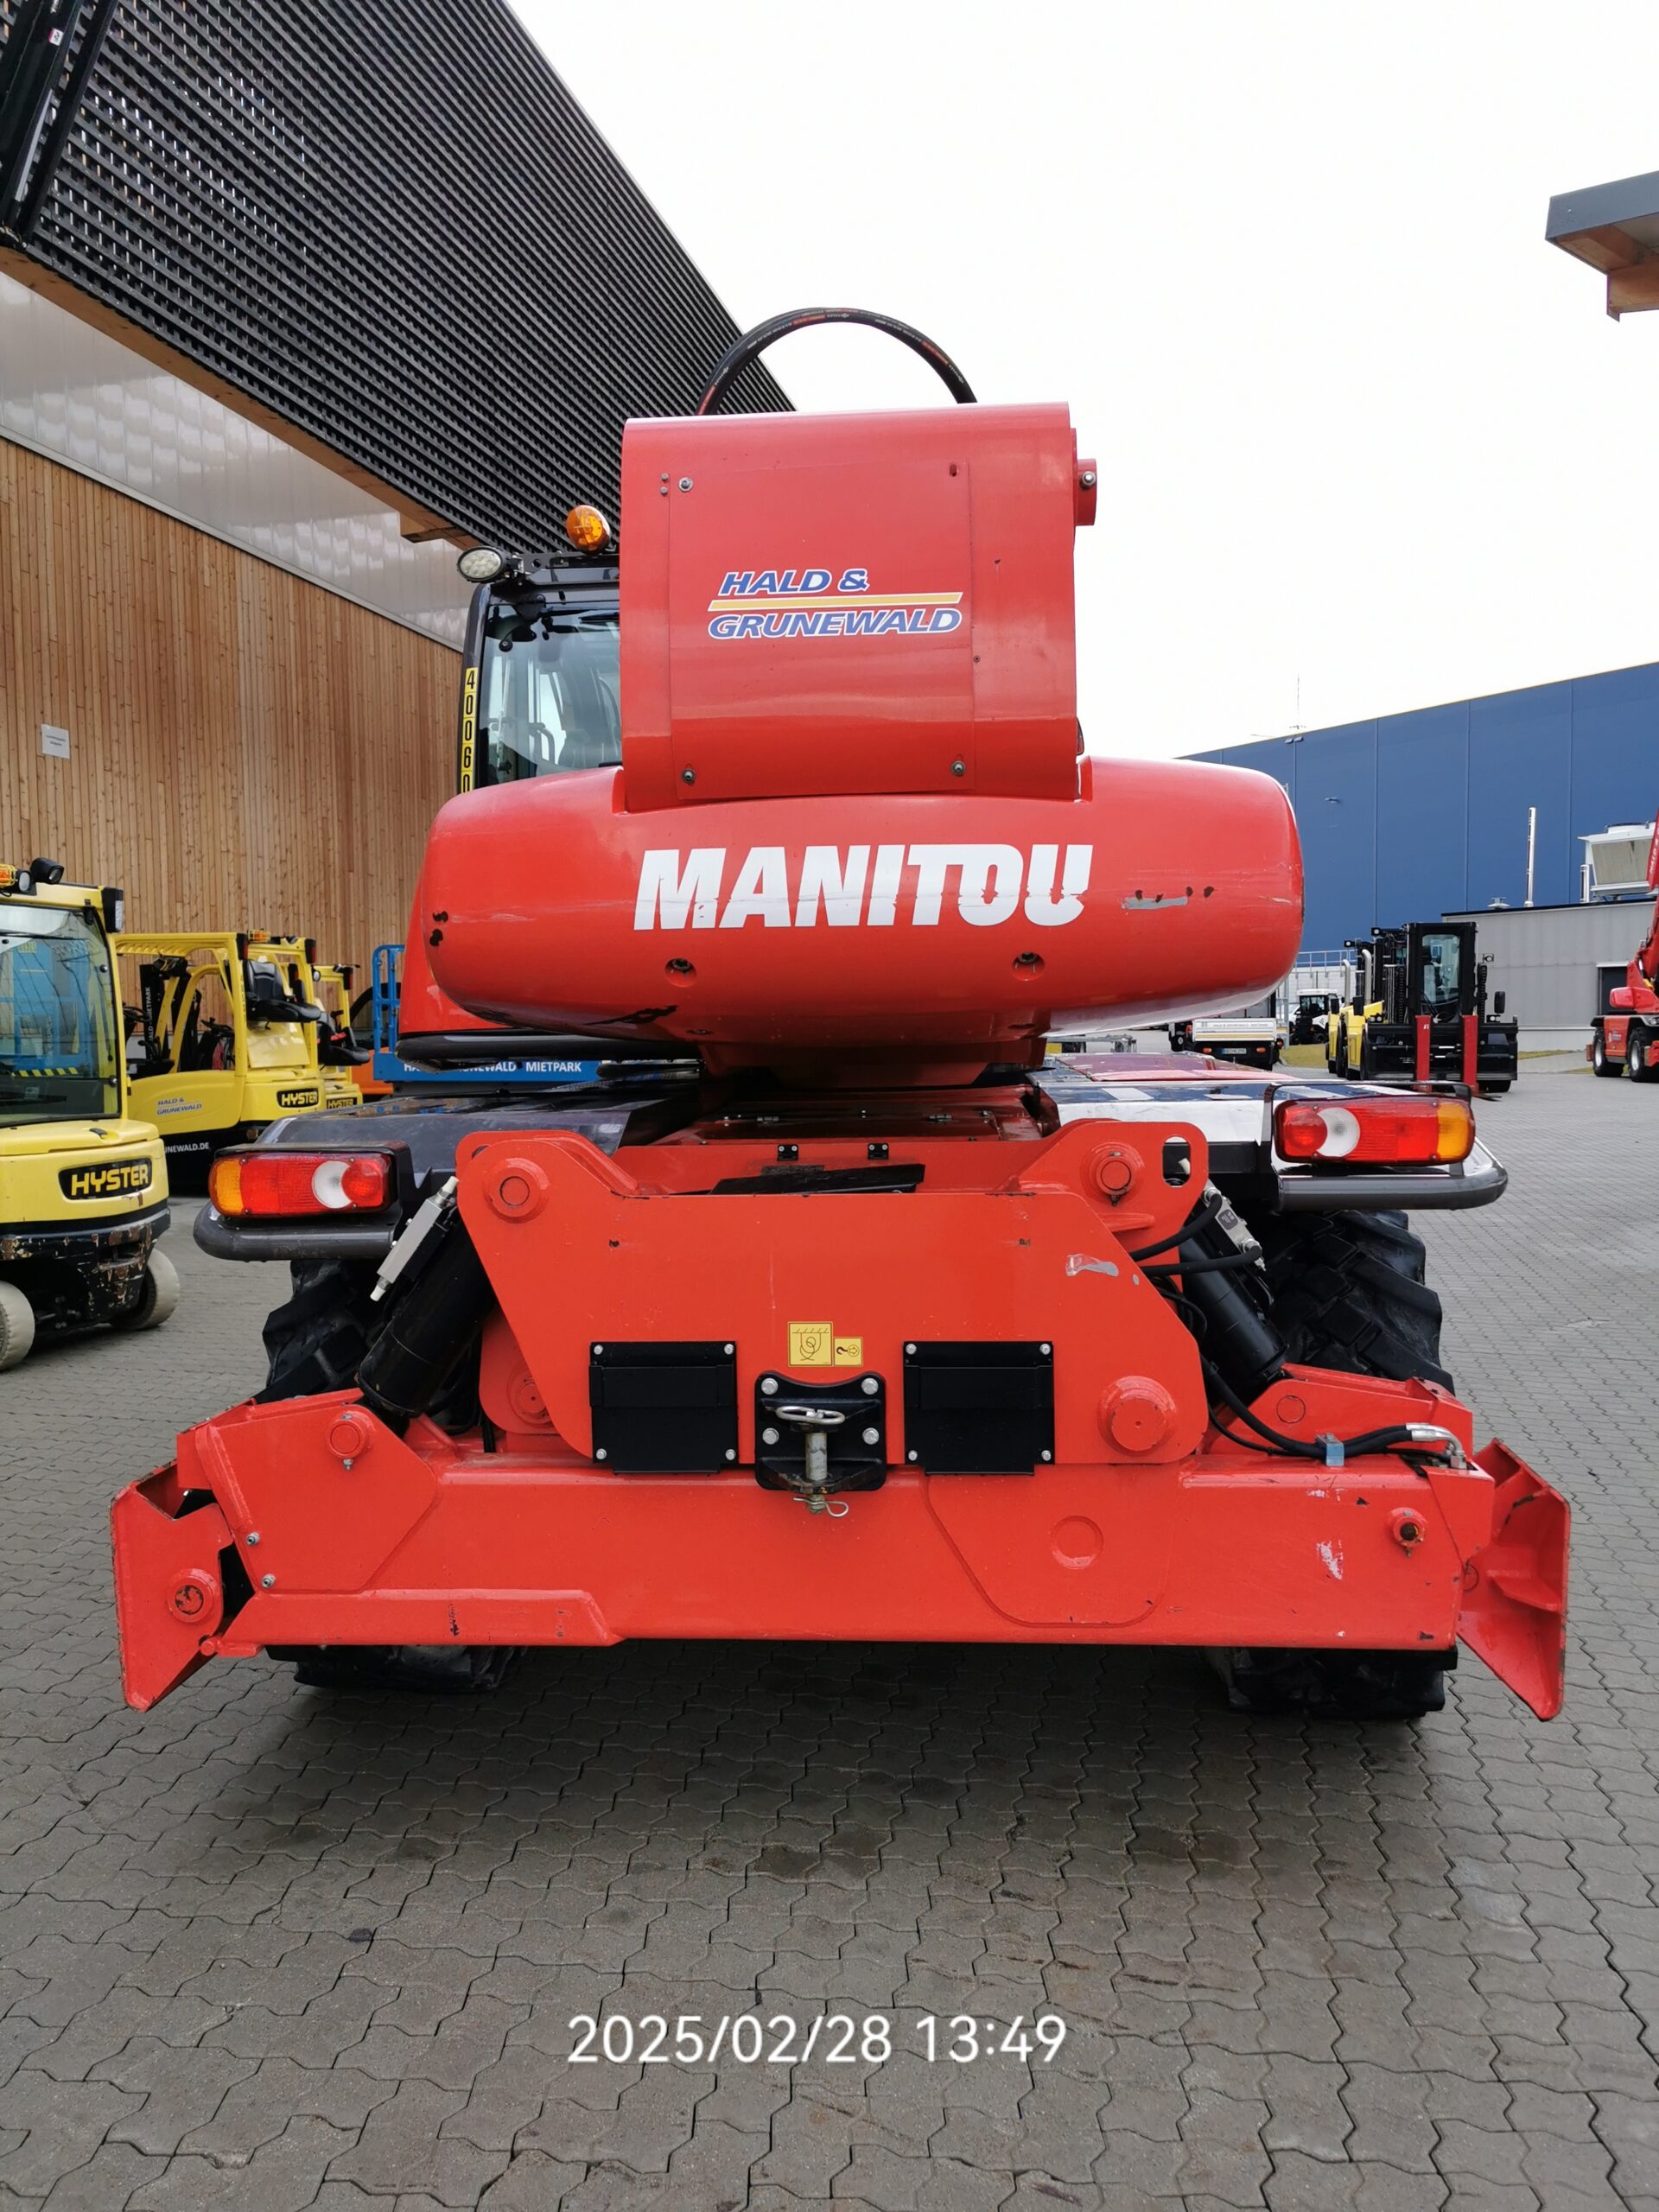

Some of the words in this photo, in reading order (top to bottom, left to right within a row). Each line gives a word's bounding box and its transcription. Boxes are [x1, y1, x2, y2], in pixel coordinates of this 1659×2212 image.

[718, 569, 832, 596] HALD
[837, 569, 869, 592] &
[708, 608, 963, 639] GRUNEWALD
[634, 844, 1093, 931] MANITOU
[525, 1061, 582, 1072] MIETPARK
[157, 1097, 178, 1106] HALD
[281, 1091, 318, 1106] HYSTER
[328, 1098, 353, 1109] HYSTER
[156, 1103, 203, 1116] GRUNEWALD
[71, 1164, 148, 1196] HYSTER
